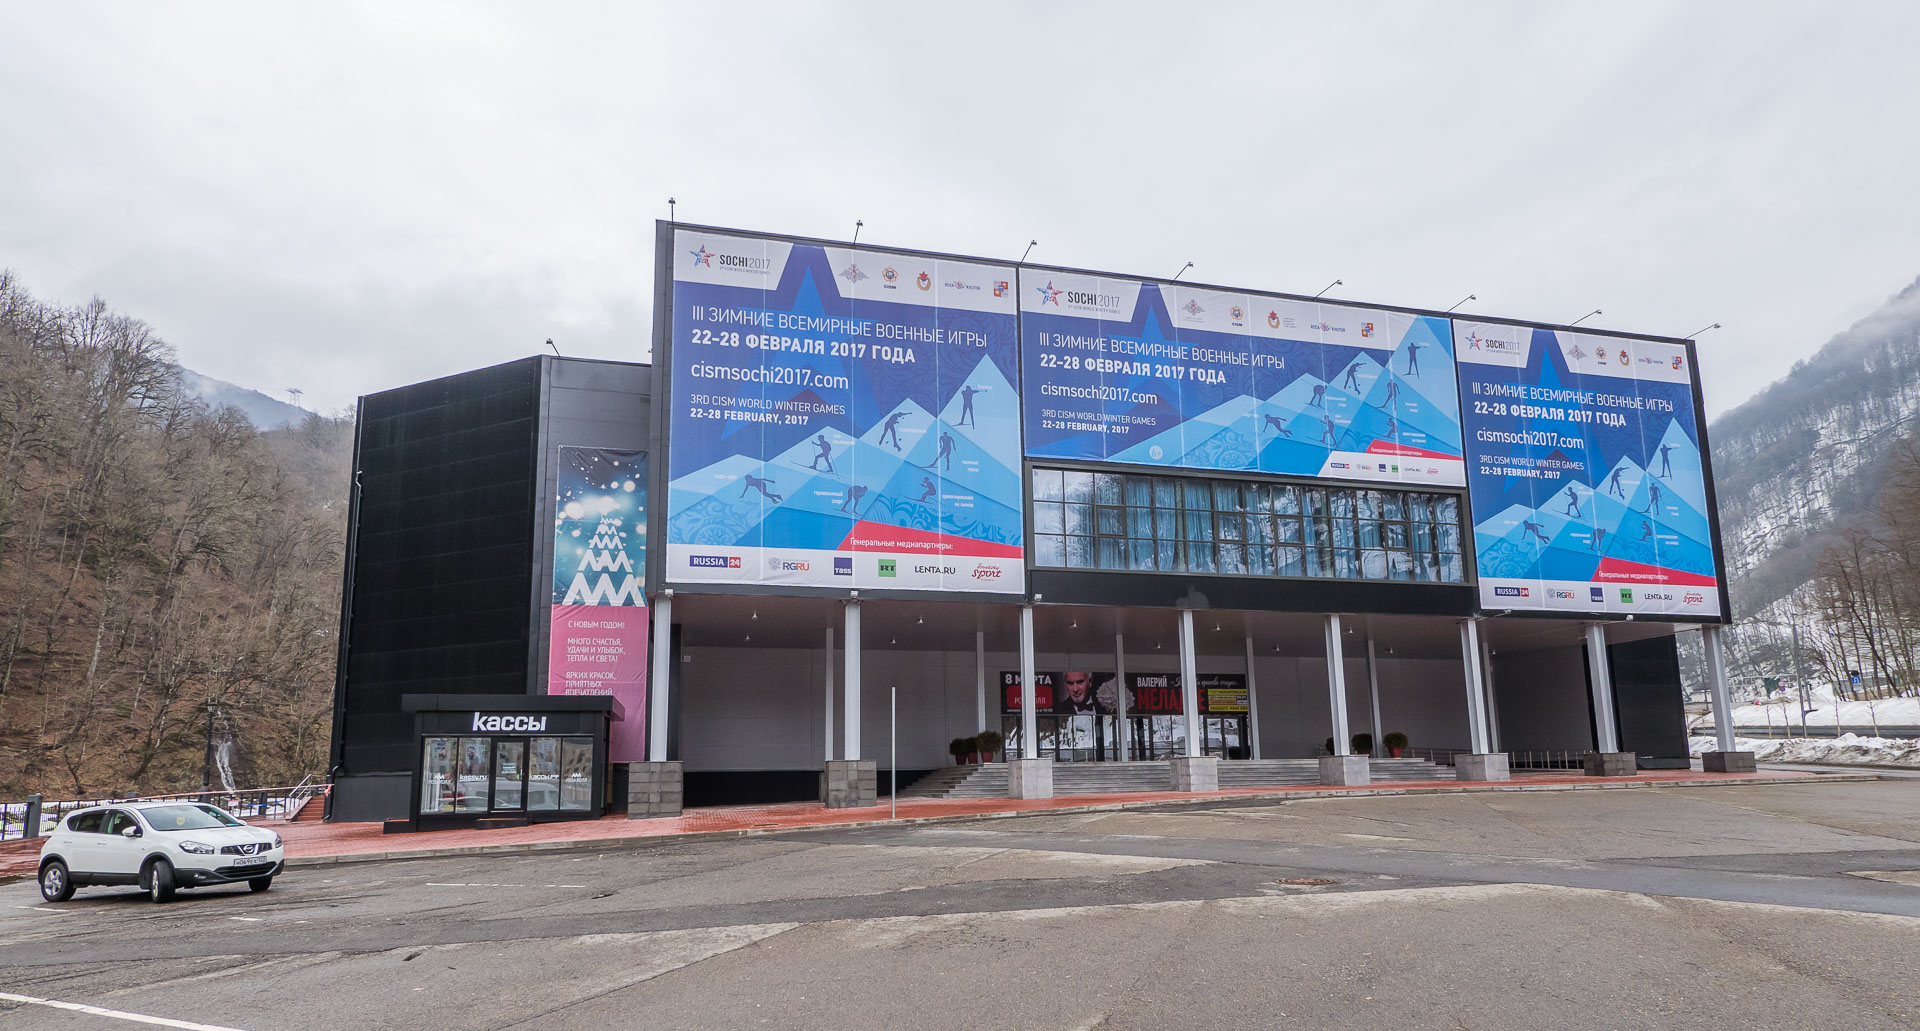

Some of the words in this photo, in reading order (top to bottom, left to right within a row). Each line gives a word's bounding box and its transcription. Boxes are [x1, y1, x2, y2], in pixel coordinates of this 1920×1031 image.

[708, 307, 774, 327] ЗИМНИЕ
[779, 314, 872, 337] ВСЕМИРНЫЕ
[876, 323, 944, 344] ВОЕННЫЕ
[949, 330, 987, 347] ИГРЫ
[692, 329, 740, 347] 22-28
[746, 334, 825, 355] ФЕВРАЛЯ
[830, 341, 866, 358] 2017
[872, 345, 916, 364] ГОДА
[1052, 333, 1107, 352] ЗИМНИЕ
[1111, 339, 1188, 360] ВСЕМИРНЫЕ
[1192, 348, 1249, 366] ВОЕННЫЕ
[1252, 354, 1285, 369] ИГРЫ
[691, 361, 849, 389] cismsochi2017.com
[1040, 353, 1080, 370] 22-28
[1084, 358, 1150, 376] ФЕВРАЛЯ
[1155, 364, 1185, 380] 2017
[1190, 368, 1226, 384] ГОДА
[1041, 381, 1158, 404] cismsochi2017.com
[1483, 382, 1528, 399] ЗИМНИЕ
[1530, 387, 1594, 405] ВСЕМИРНЫЕ
[1596, 393, 1643, 409] ВОЕННЫЕ
[1645, 398, 1673, 412] ИГРЫ
[691, 394, 710, 405] 3RD
[712, 396, 735, 407] CISM
[738, 398, 772, 410] WORLD
[775, 400, 811, 412] WINTER
[813, 403, 845, 414] GAMES
[690, 408, 721, 419] 22-28
[724, 410, 782, 425] FEBRUARY,
[785, 414, 809, 425] 2017
[1042, 409, 1056, 418] 3RD
[1058, 411, 1075, 419] CISM
[1076, 412, 1102, 421] WORLD
[1103, 414, 1130, 424] WINTER
[1132, 416, 1156, 426] GAMES
[1474, 401, 1507, 416] 22-28
[1510, 404, 1565, 421] ФЕВРАЛЯ
[1568, 409, 1592, 424] 2017
[1596, 412, 1627, 428] ГОДА
[1042, 420, 1065, 429] 22-28
[1067, 422, 1110, 433] FEBRUARY,
[1111, 425, 1130, 434] 2017
[1476, 427, 1584, 449] cismsochi2017.com
[1479, 455, 1493, 464] 3RD
[1494, 455, 1510, 465] CISM
[1512, 457, 1534, 467] WORLD
[1536, 459, 1561, 469] WINTER
[1561, 461, 1584, 471] GAMES
[1480, 466, 1502, 475] 22-28
[1503, 468, 1543, 480] FEBRUARY,
[1544, 470, 1561, 480] 2017
[850, 537, 895, 547] Генеральные
[693, 557, 725, 566] RUSSIA
[730, 558, 740, 566] 24
[783, 562, 809, 571] RGRU
[914, 566, 956, 574] LENTA.RU
[568, 620, 573, 628] С
[573, 621, 599, 629] НОВЫМ
[600, 621, 625, 629] ГОДОМ!
[567, 637, 591, 645] МНОГО
[567, 654, 588, 662] ТЕПЛА
[597, 646, 626, 655] УЛЫБОК,
[589, 672, 616, 680] КРАСОК,
[1005, 673, 1013, 685] 8
[1137, 675, 1168, 688] ВАЛЕРИЙ
[472, 712, 547, 731] кассы
